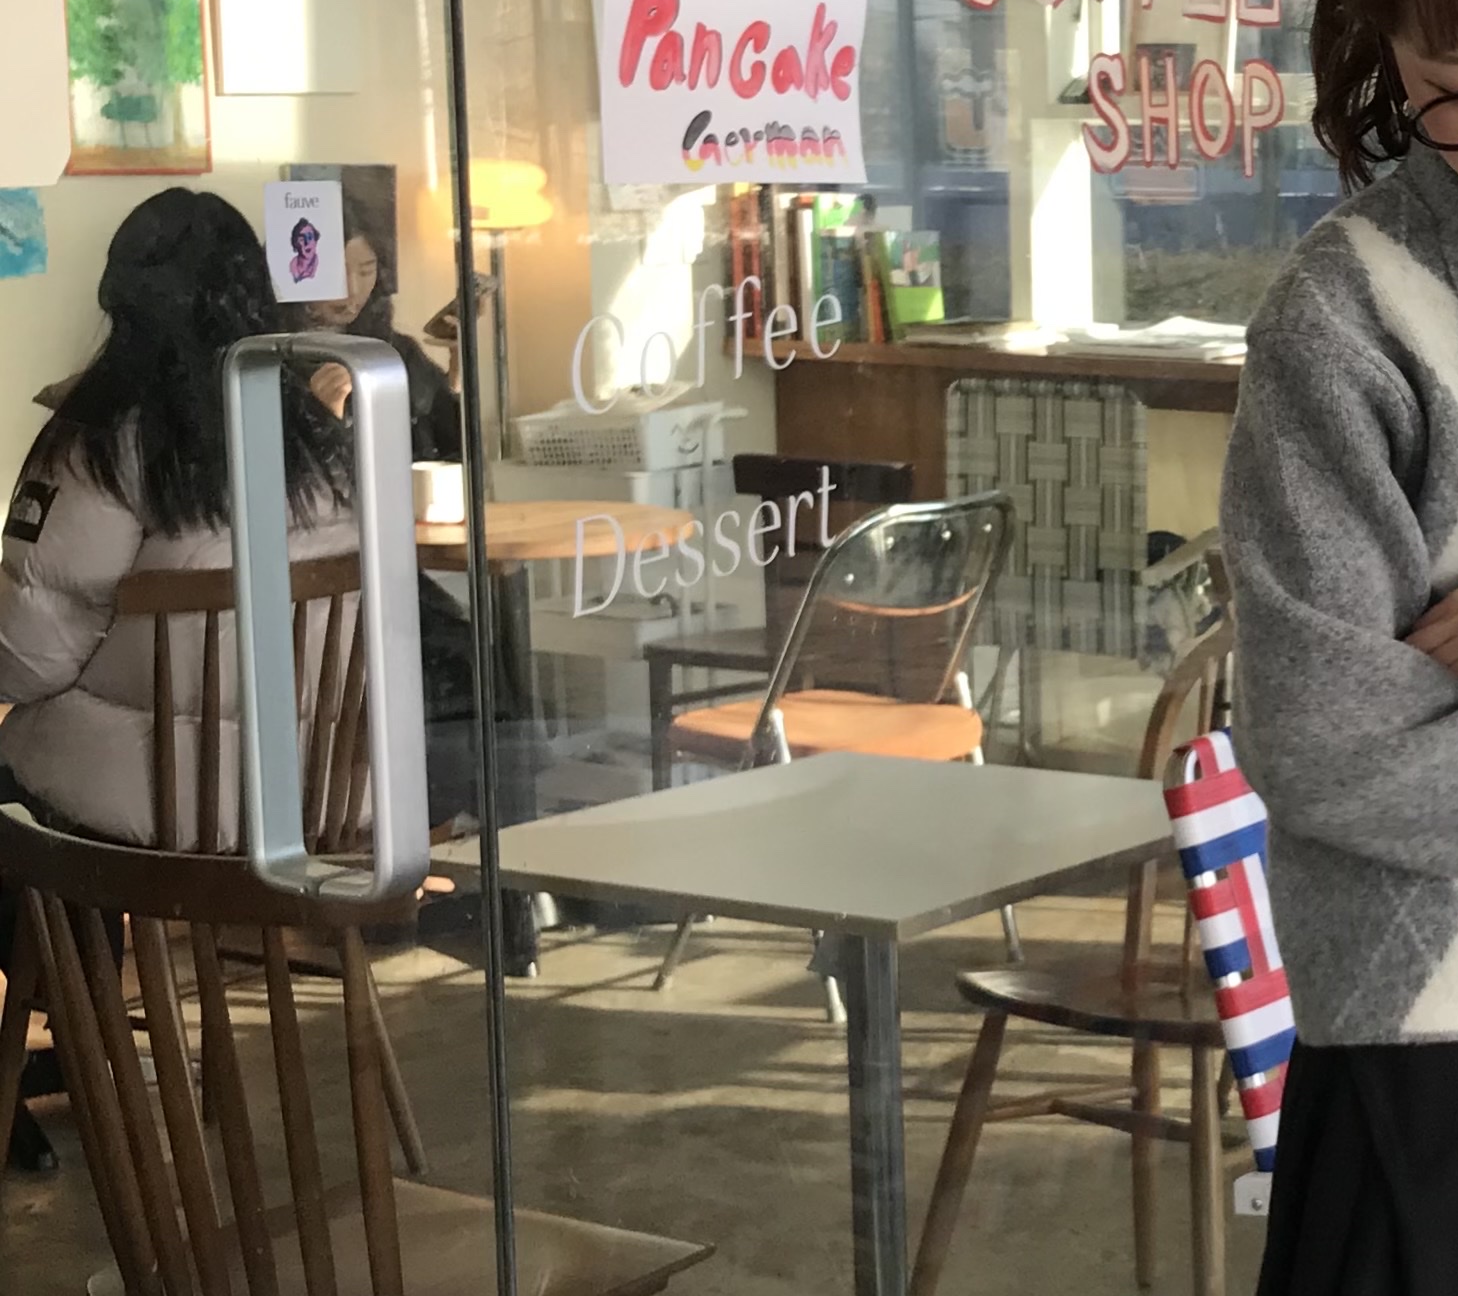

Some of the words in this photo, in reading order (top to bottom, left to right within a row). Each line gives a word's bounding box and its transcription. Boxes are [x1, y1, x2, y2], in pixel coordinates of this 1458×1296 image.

[1082, 52, 1285, 178] SHOP
[284, 192, 320, 209] fauve
[572, 275, 842, 416] Coffee
[573, 465, 838, 619] Dessert
